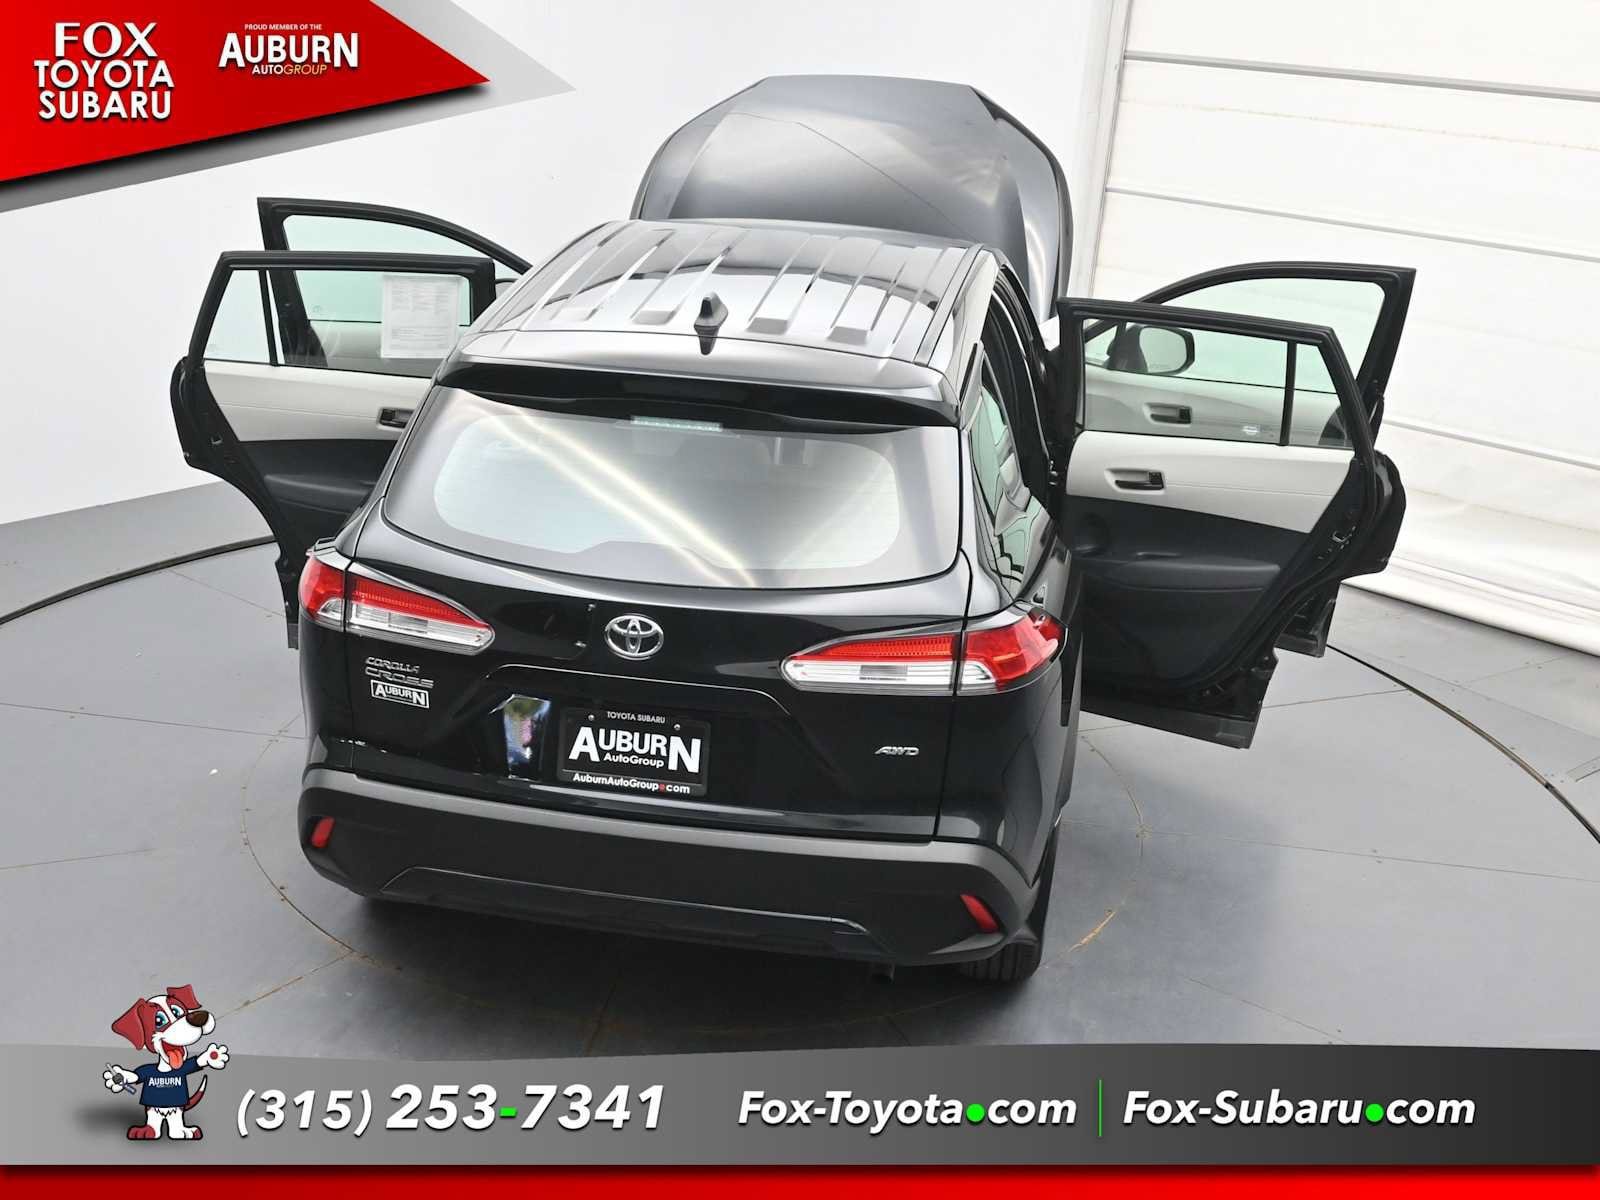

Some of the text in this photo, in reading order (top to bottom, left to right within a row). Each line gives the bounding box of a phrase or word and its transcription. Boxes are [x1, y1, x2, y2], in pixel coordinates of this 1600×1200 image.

[365, 656, 420, 674] COROLLA
[365, 666, 434, 689] CROSS
[374, 683, 426, 706] AUBURN
[607, 711, 666, 724] TOYOTA SUBARU
[568, 726, 702, 773] AUBURN
[874, 746, 920, 756] AWD
[603, 752, 665, 769] AutoGroup
[572, 773, 691, 795] AuburnAutoGroup.com
